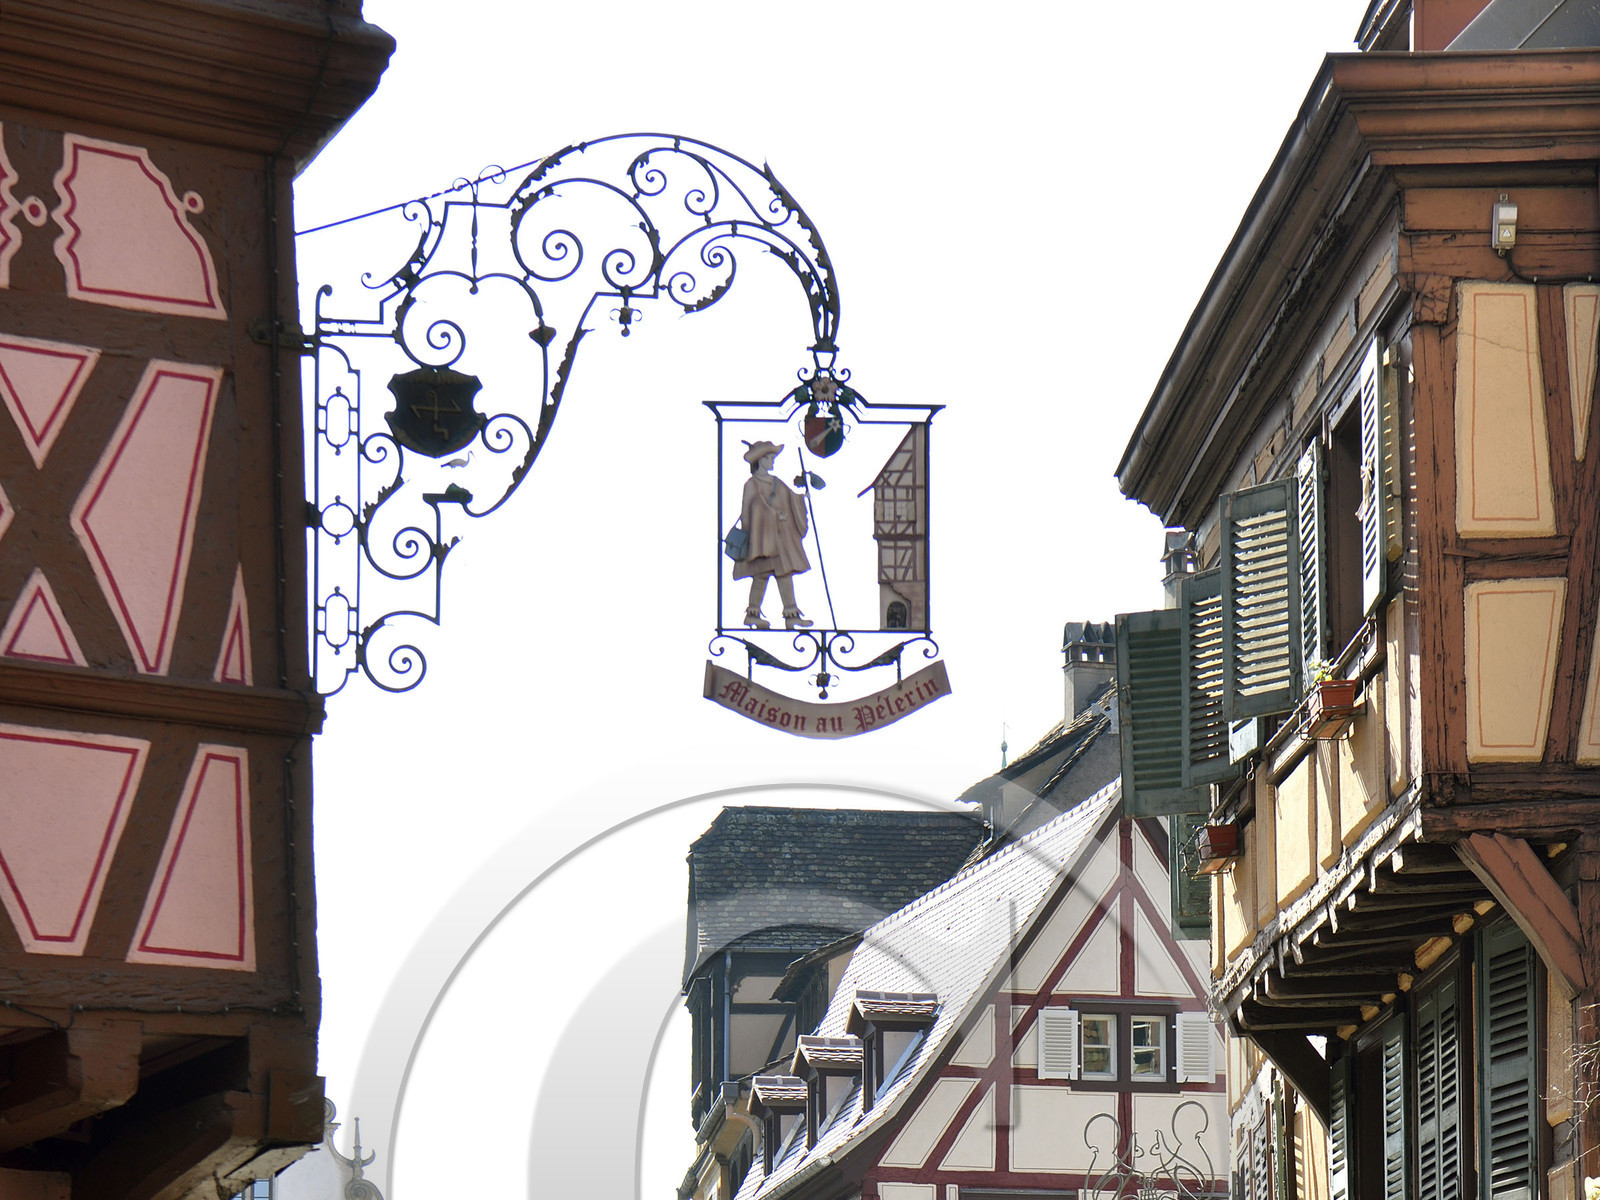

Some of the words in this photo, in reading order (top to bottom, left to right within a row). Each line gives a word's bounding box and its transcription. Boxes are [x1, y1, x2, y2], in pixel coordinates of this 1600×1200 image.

[719, 681, 807, 731] Maison
[816, 716, 844, 733] au
[852, 678, 940, 732] Pélerin
